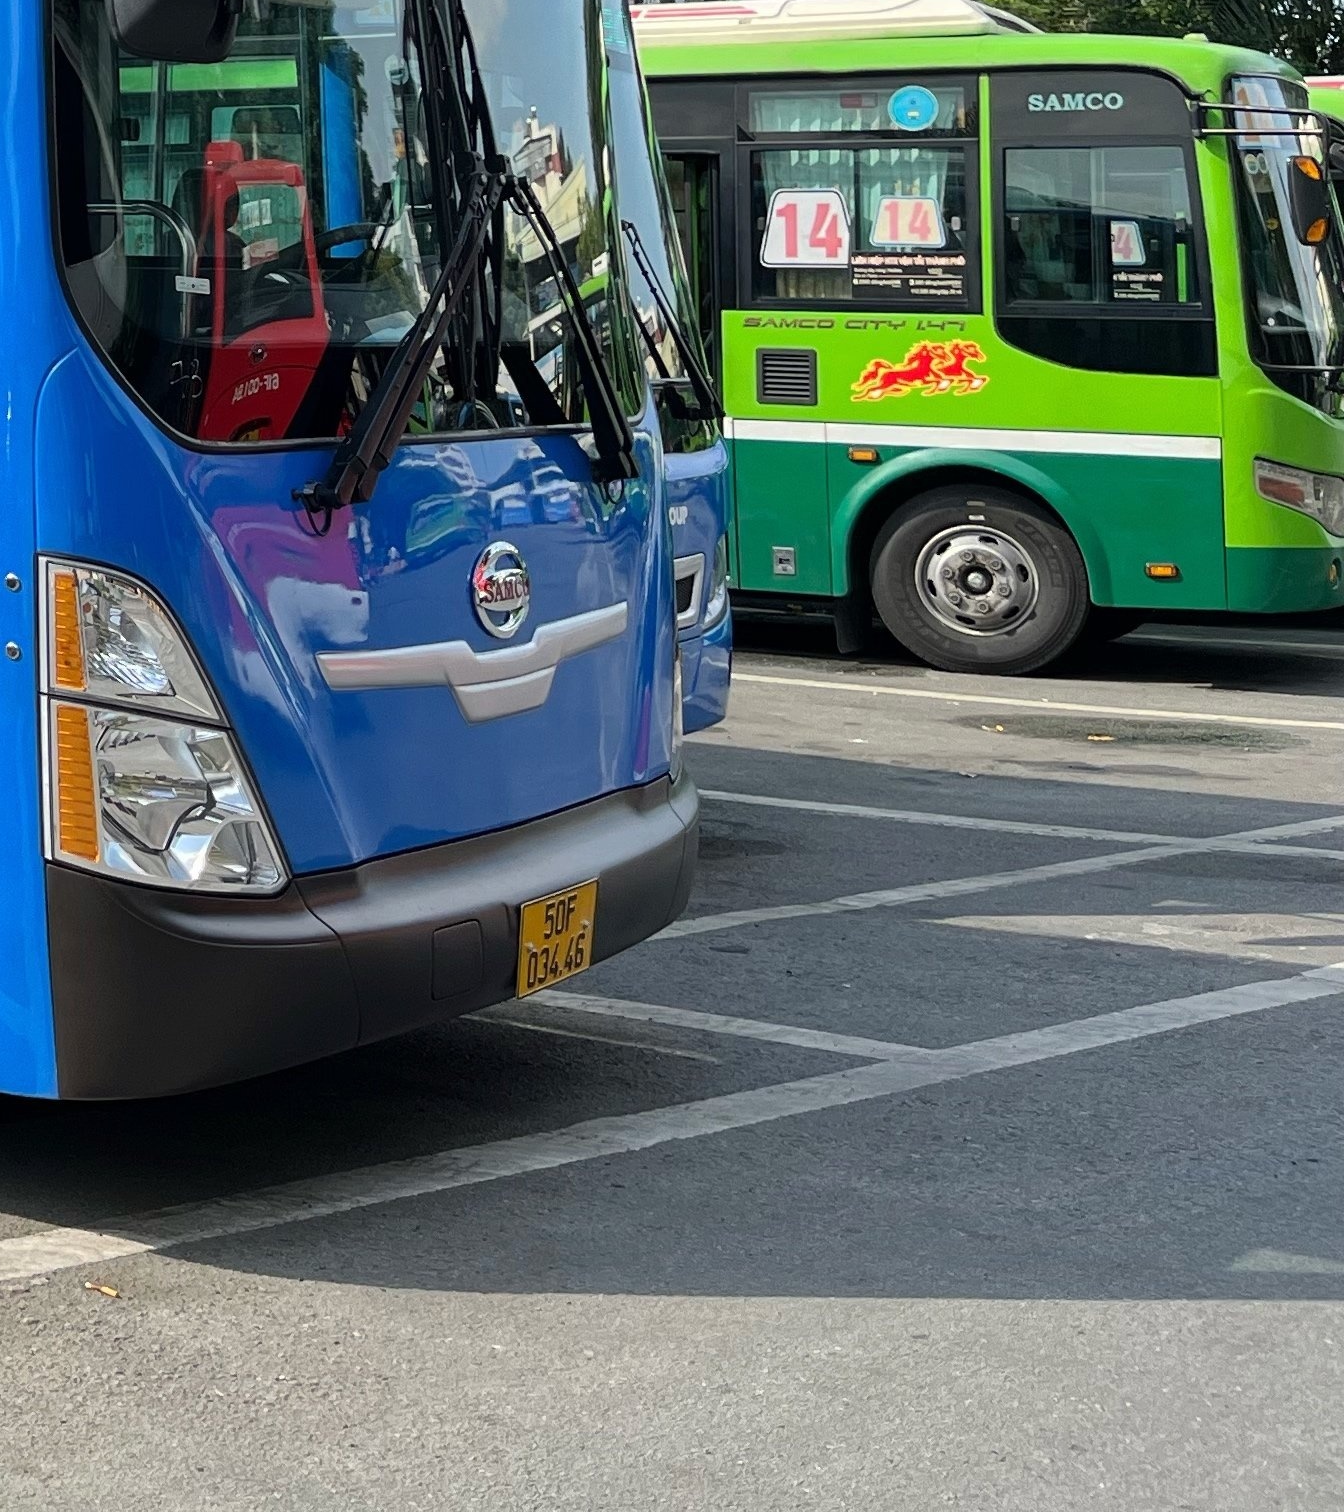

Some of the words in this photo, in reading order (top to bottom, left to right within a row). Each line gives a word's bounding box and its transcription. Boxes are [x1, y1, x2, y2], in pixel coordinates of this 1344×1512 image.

[1028, 91, 1125, 113] SAMCO
[775, 202, 843, 259] 14
[883, 200, 932, 242] 14
[743, 317, 835, 330] SAMCO
[844, 319, 907, 331] CITY
[668, 505, 689, 526] OUP
[543, 891, 578, 940] 50F
[527, 930, 586, 989] 034.46
